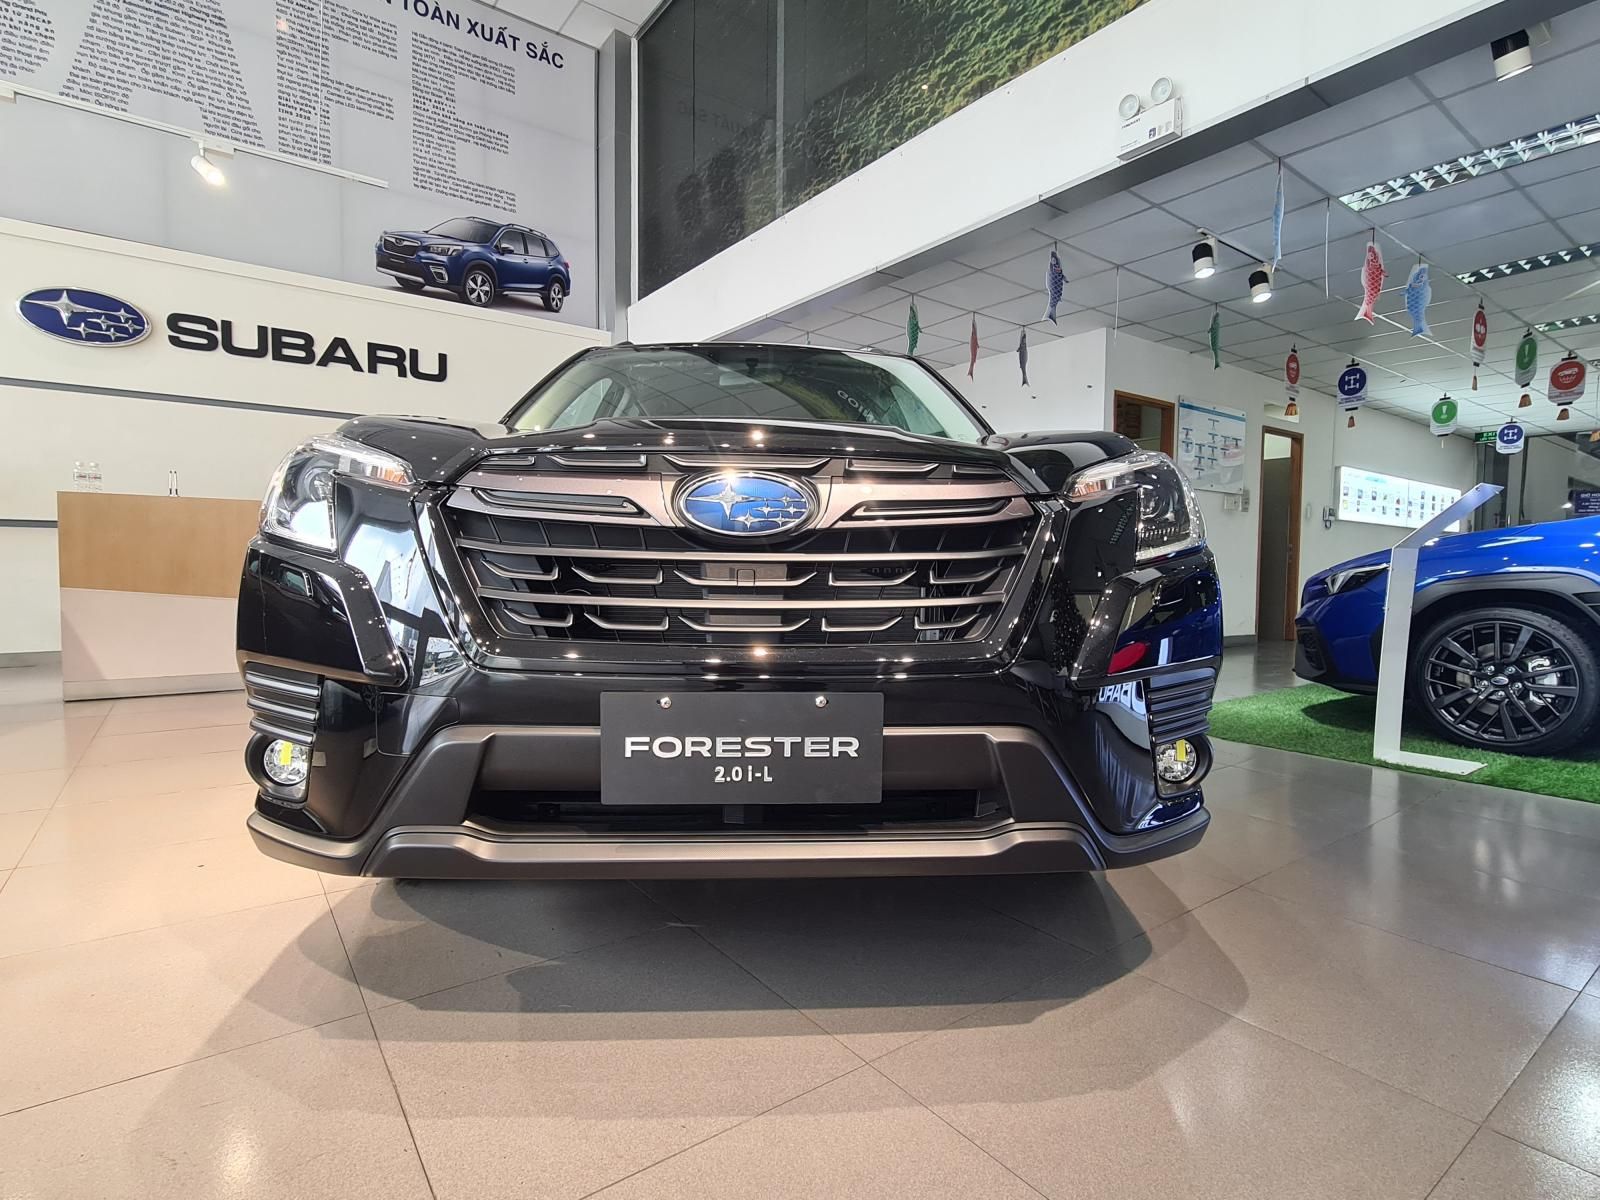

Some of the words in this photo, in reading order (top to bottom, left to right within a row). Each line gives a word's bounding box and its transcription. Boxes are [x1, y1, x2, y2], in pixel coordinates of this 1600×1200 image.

[467, 17, 521, 52] XUẤT
[526, 41, 564, 69] SẮC
[166, 312, 447, 382] SUBARU
[624, 736, 860, 758] FORESTER
